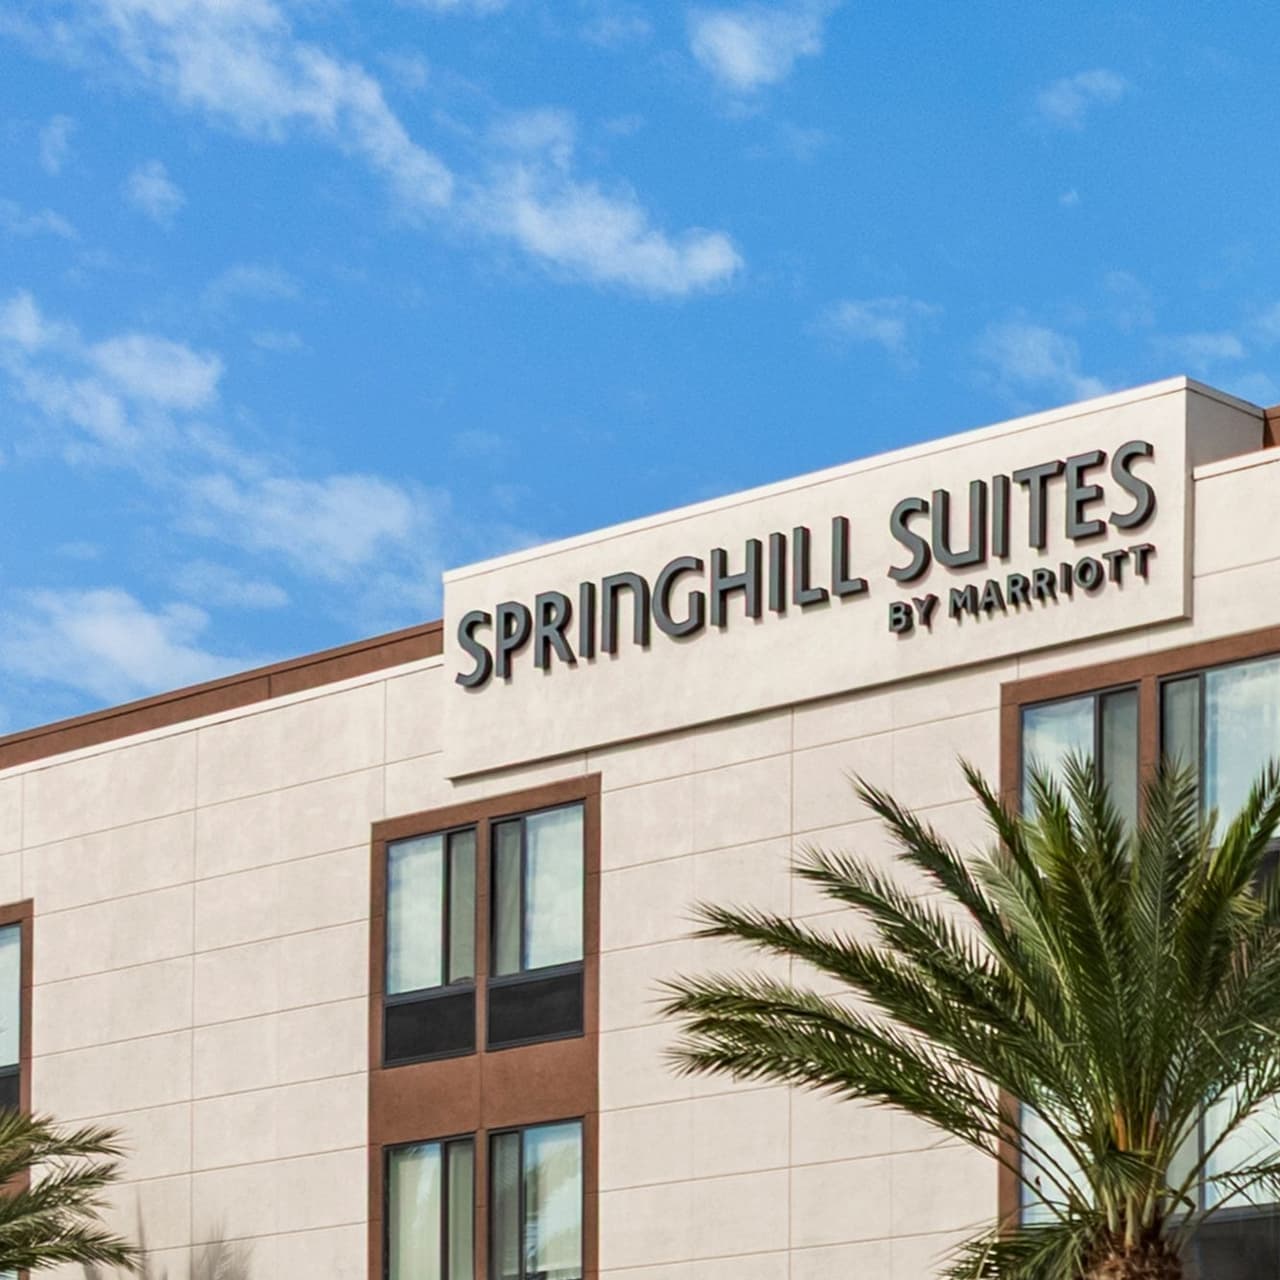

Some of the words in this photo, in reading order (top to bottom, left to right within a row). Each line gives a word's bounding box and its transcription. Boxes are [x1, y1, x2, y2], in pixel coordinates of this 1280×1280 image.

[454, 515, 870, 689] SPRINGHILL
[886, 438, 1158, 584] SUITES
[887, 596, 938, 635] BY
[948, 543, 1157, 621] MARRIOTT
